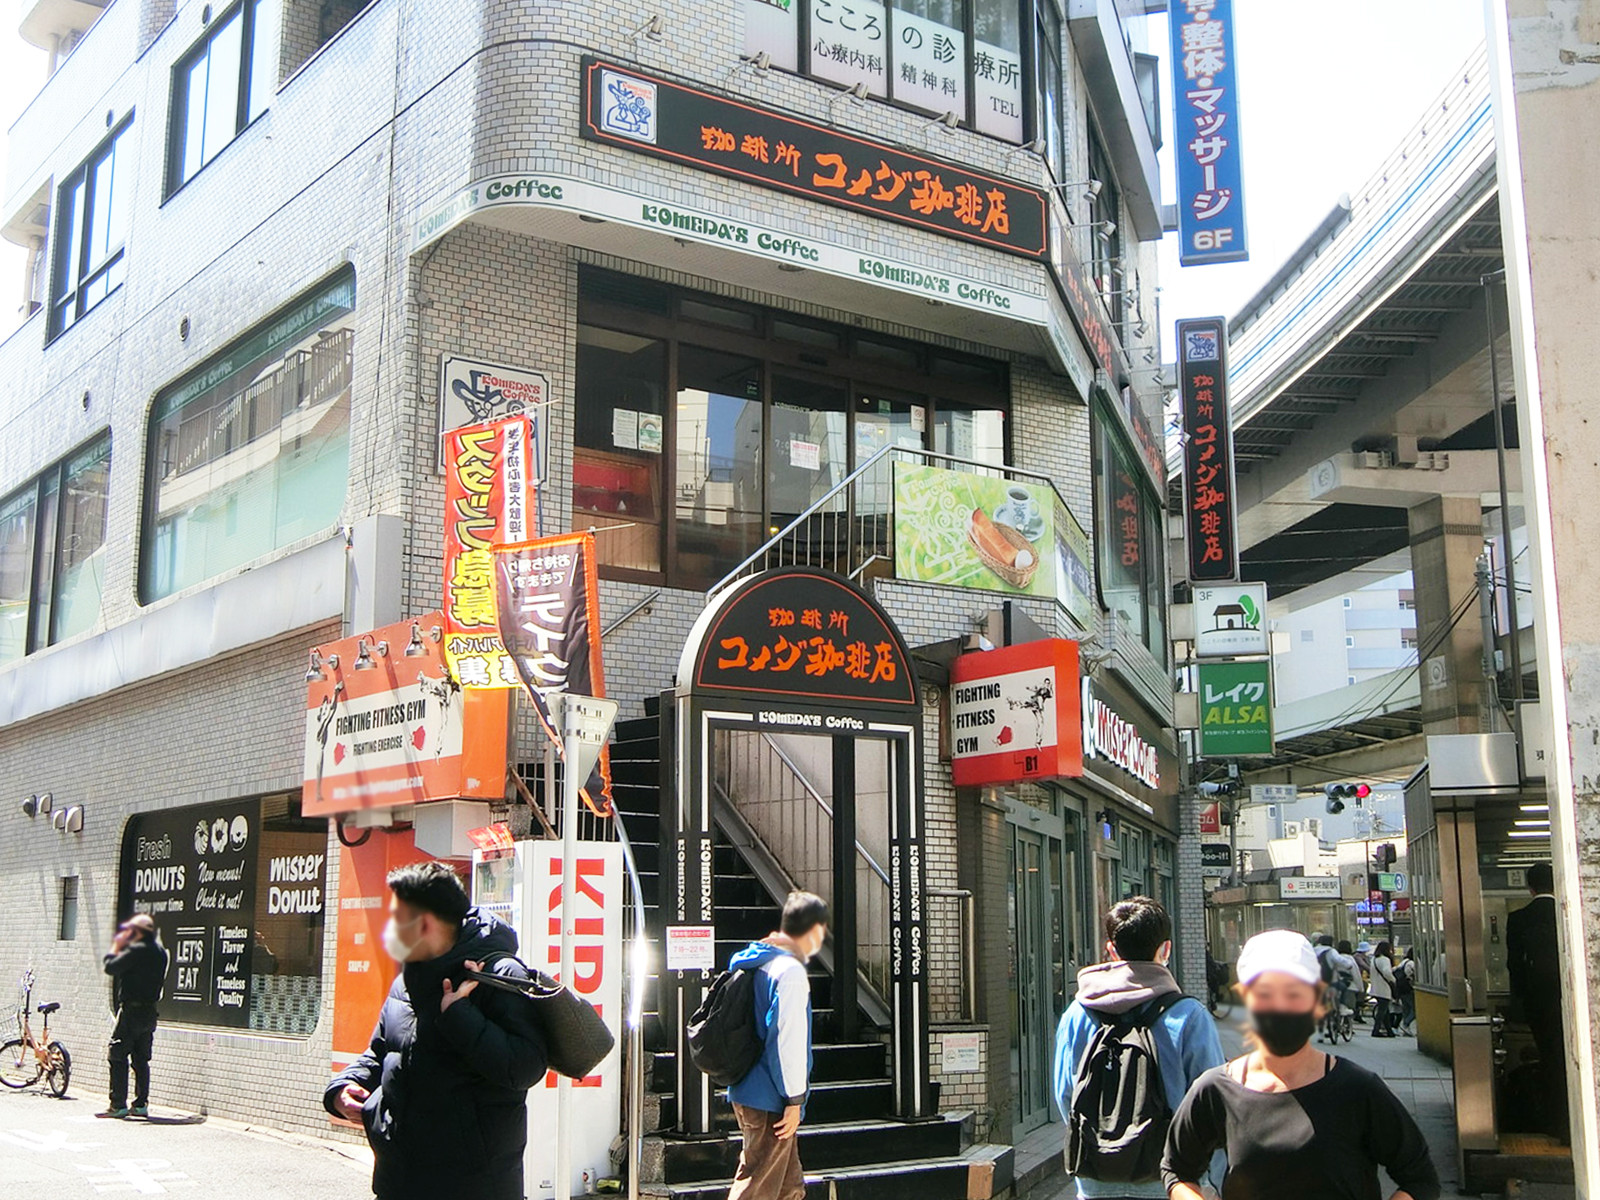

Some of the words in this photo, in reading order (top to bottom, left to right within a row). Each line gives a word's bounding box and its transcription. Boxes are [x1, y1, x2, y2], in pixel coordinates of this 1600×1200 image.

[814, 37, 883, 76] 心療内科
[901, 62, 957, 98] 精神科
[990, 96, 1019, 119] TEL
[700, 125, 800, 177] 珈琲所
[813, 152, 1010, 236] コメダ珈琲店
[1193, 229, 1232, 250] 6F
[482, 375, 541, 395] KOMEDA'S
[502, 388, 541, 404] Coffee
[1194, 424, 1225, 564] コメダ珈琲店
[1200, 591, 1212, 601] 3F
[768, 607, 850, 637] 珈琲所
[718, 635, 897, 684] コメダ珈琲店
[956, 683, 1001, 705] FIGHTING
[1205, 682, 1265, 704] レイク
[336, 710, 371, 737] FIGHTING
[372, 704, 405, 730] FITNESS
[406, 699, 426, 722] GYM
[759, 711, 822, 727] KOMEDA'S
[956, 709, 996, 730] FITNESS
[1204, 706, 1268, 725] ALSA
[957, 737, 979, 754] GYM
[1025, 755, 1038, 772] B1
[136, 833, 172, 862] Fresh
[135, 865, 185, 893] DONUTS
[268, 887, 322, 914] Donut
[176, 940, 204, 963] LET'S
[177, 968, 200, 990] EAT
[217, 990, 245, 1008] Quality
